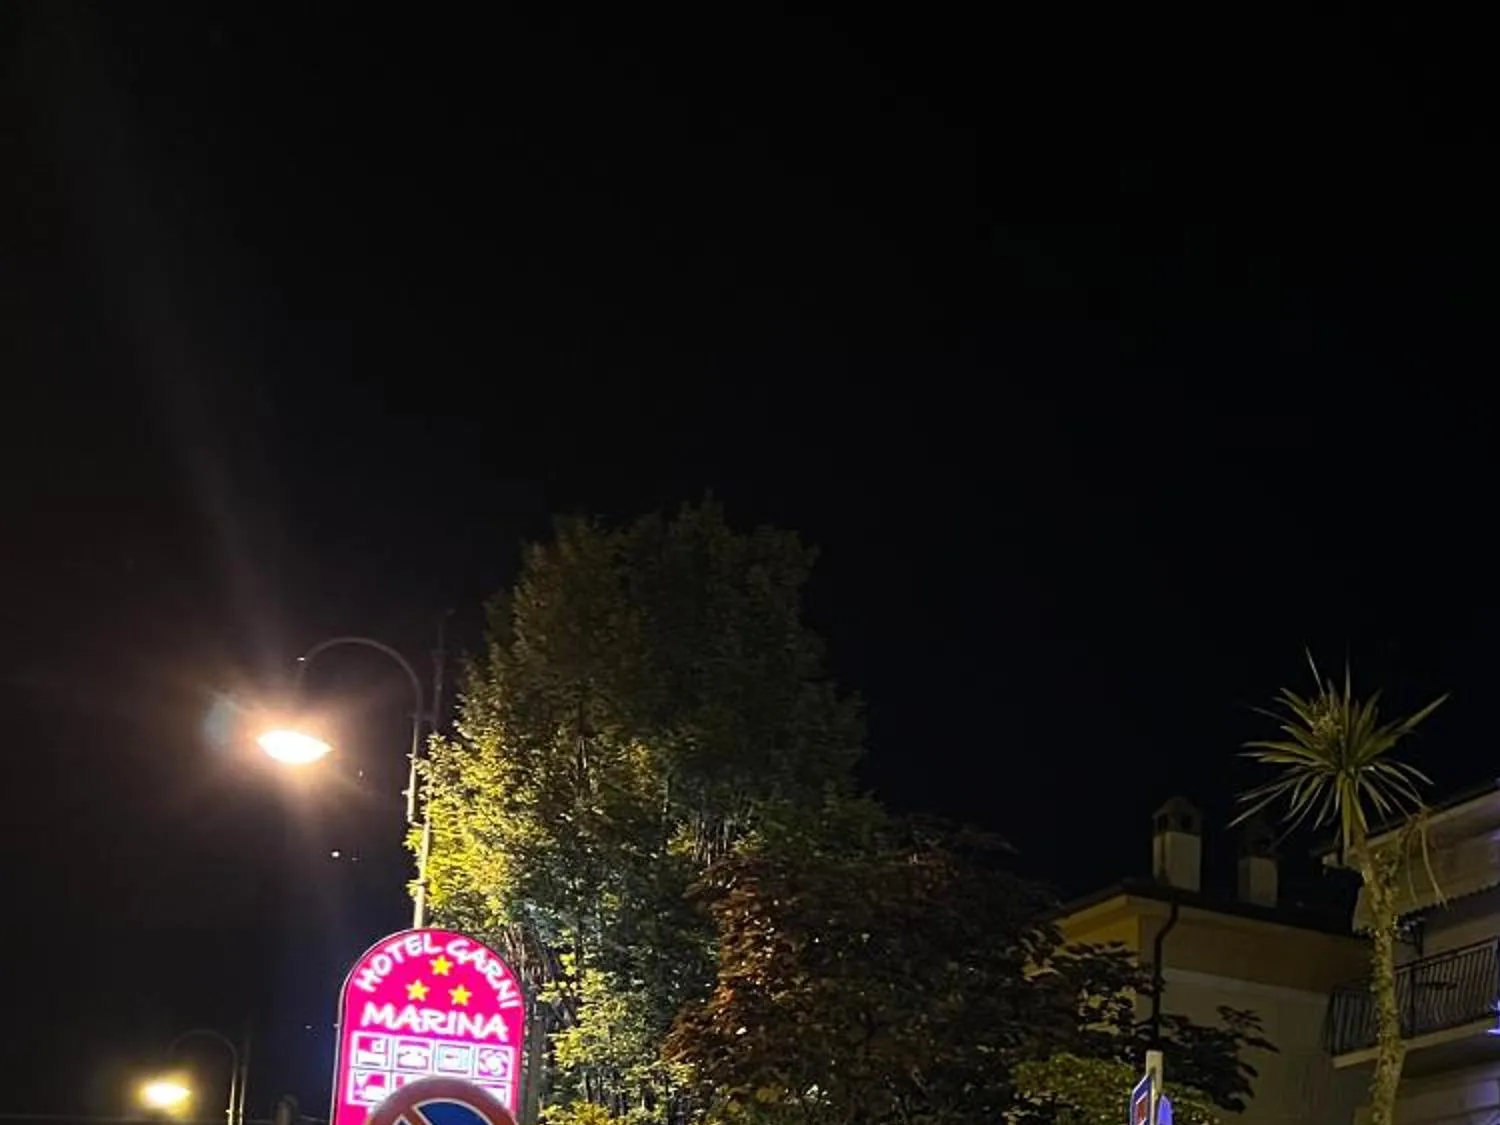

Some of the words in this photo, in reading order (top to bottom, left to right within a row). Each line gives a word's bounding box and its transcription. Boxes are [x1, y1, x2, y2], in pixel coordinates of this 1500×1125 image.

[354, 932, 442, 993] HOTEL
[446, 938, 520, 1009] GARNI
[361, 1001, 509, 1042] MARINA
